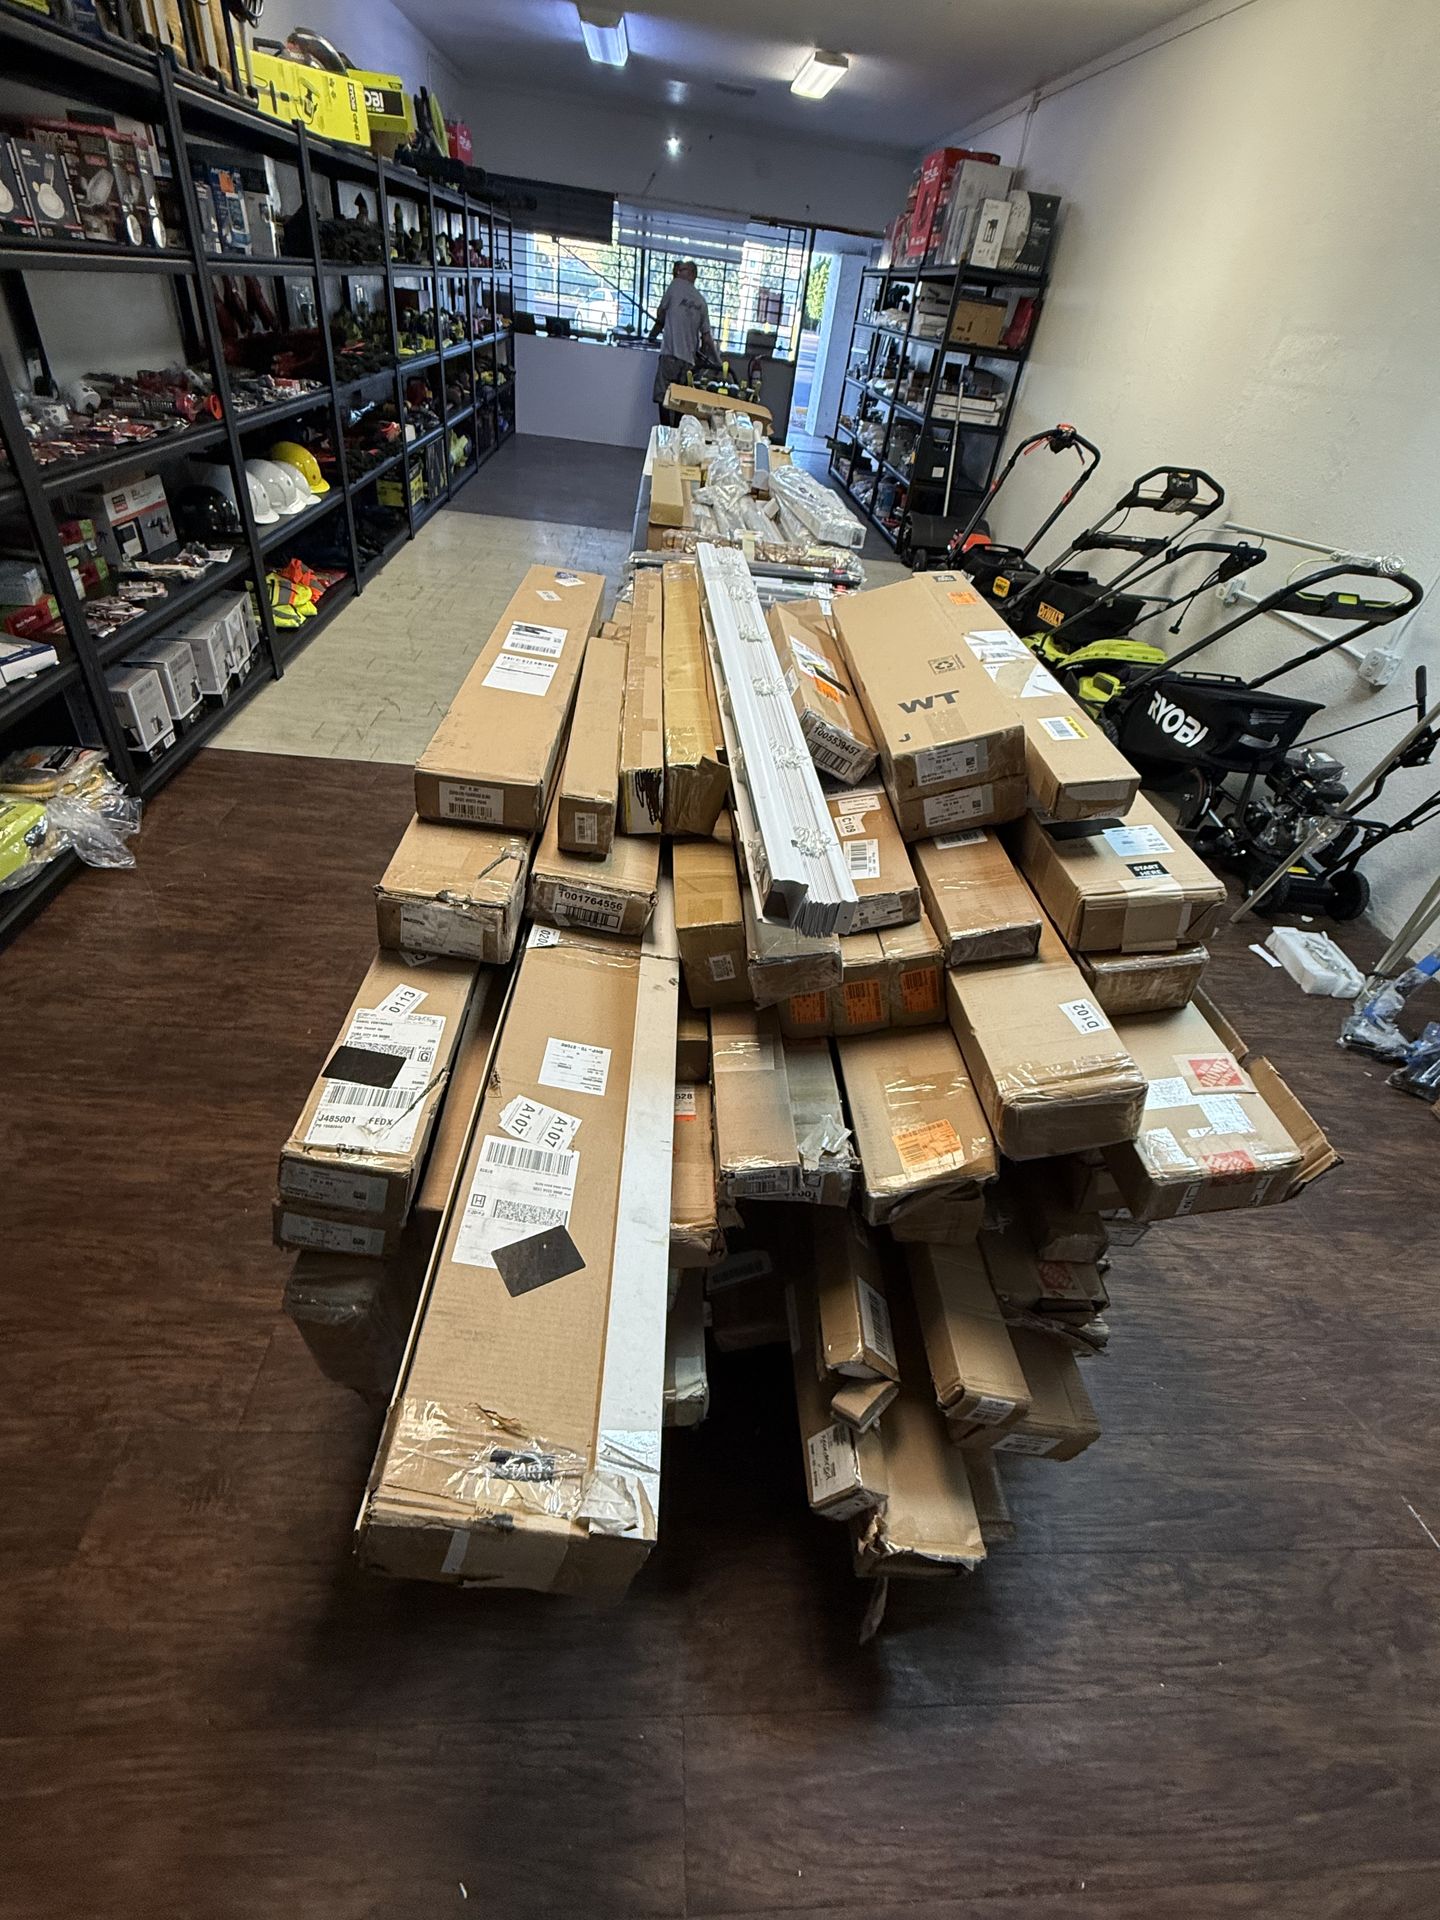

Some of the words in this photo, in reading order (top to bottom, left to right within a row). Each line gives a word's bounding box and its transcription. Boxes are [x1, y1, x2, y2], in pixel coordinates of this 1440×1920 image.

[898, 689, 960, 714] WT
[1147, 690, 1209, 748] RYOBI
[813, 725, 861, 756] 1005539457
[1133, 864, 1160, 872] START
[557, 889, 624, 912] 1001764556
[388, 990, 416, 1013] 0113
[1072, 1004, 1099, 1029] D102
[419, 1051, 430, 1062] G
[317, 1115, 356, 1124] J485001
[368, 1116, 394, 1126] FEDX
[511, 1103, 536, 1134] A107
[544, 1116, 568, 1148] A107
[474, 1195, 483, 1205] H
[501, 1462, 546, 1480] START
